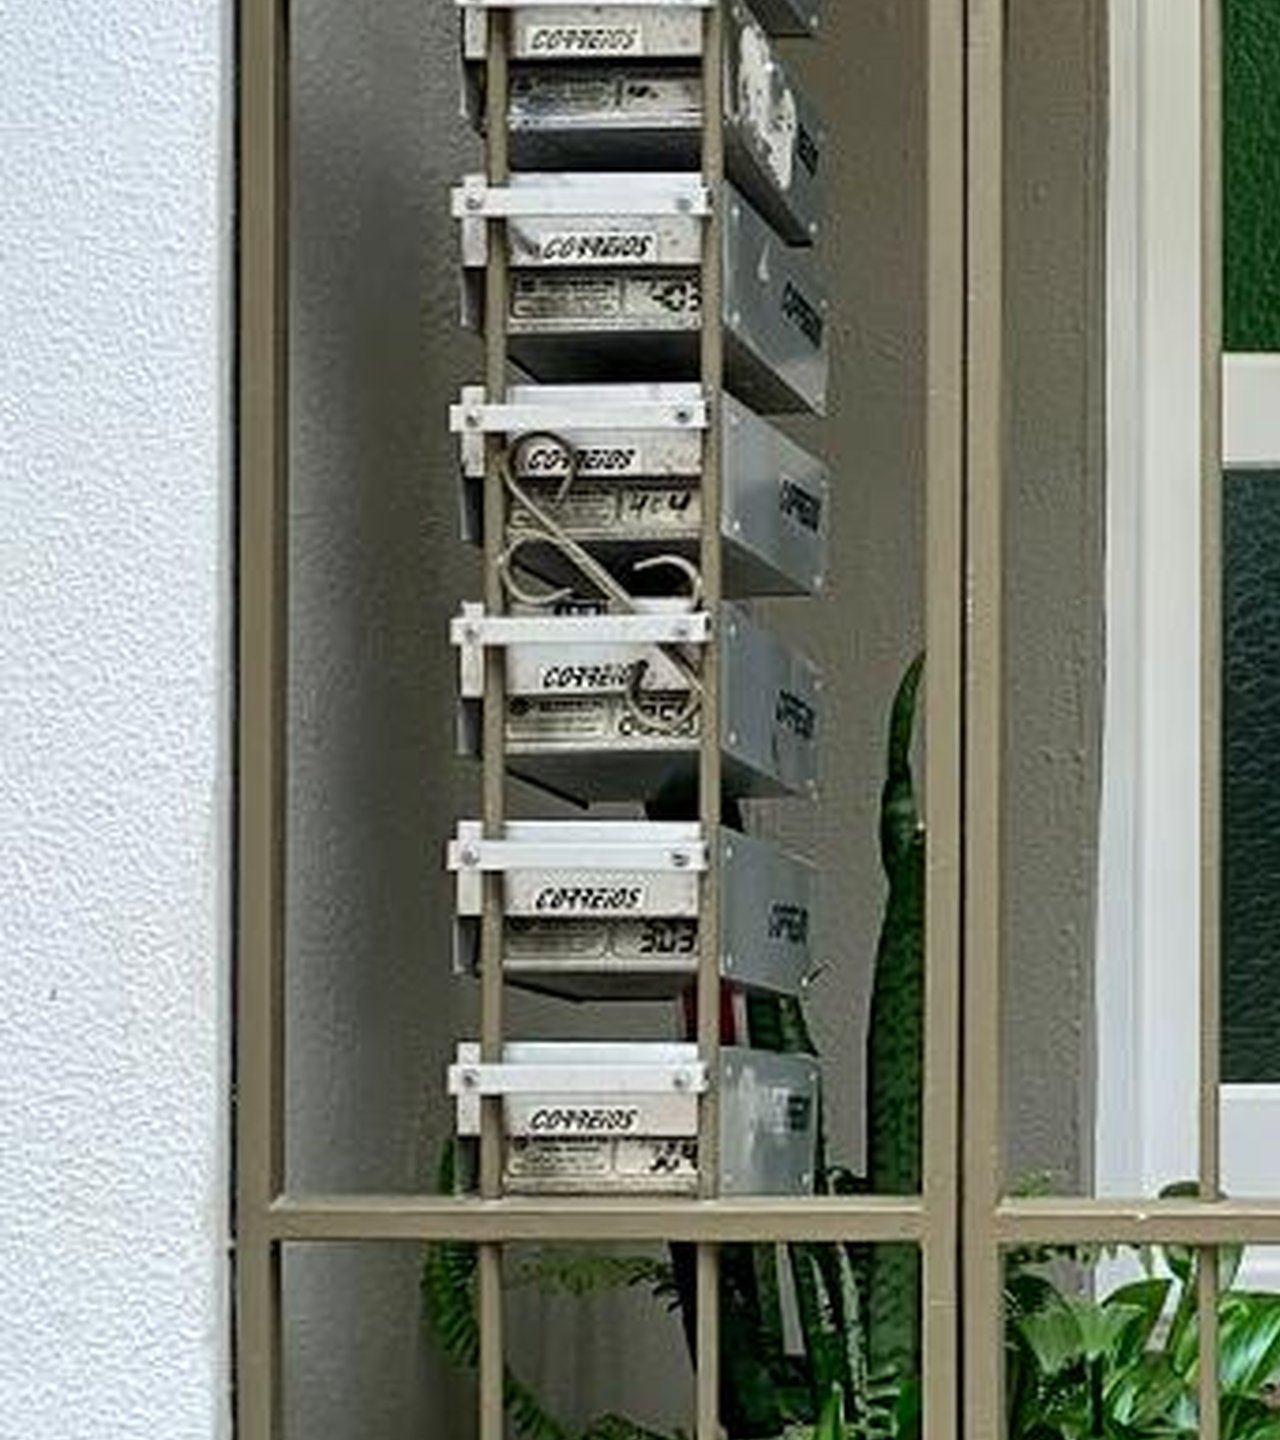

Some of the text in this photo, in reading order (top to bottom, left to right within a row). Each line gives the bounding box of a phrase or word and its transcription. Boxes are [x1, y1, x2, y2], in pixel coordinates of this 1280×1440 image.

[530, 28, 639, 51] CORREIOS
[543, 235, 655, 259] CORREIOS
[535, 887, 642, 911] CORREIOS
[530, 1109, 639, 1131] CORREIOS
